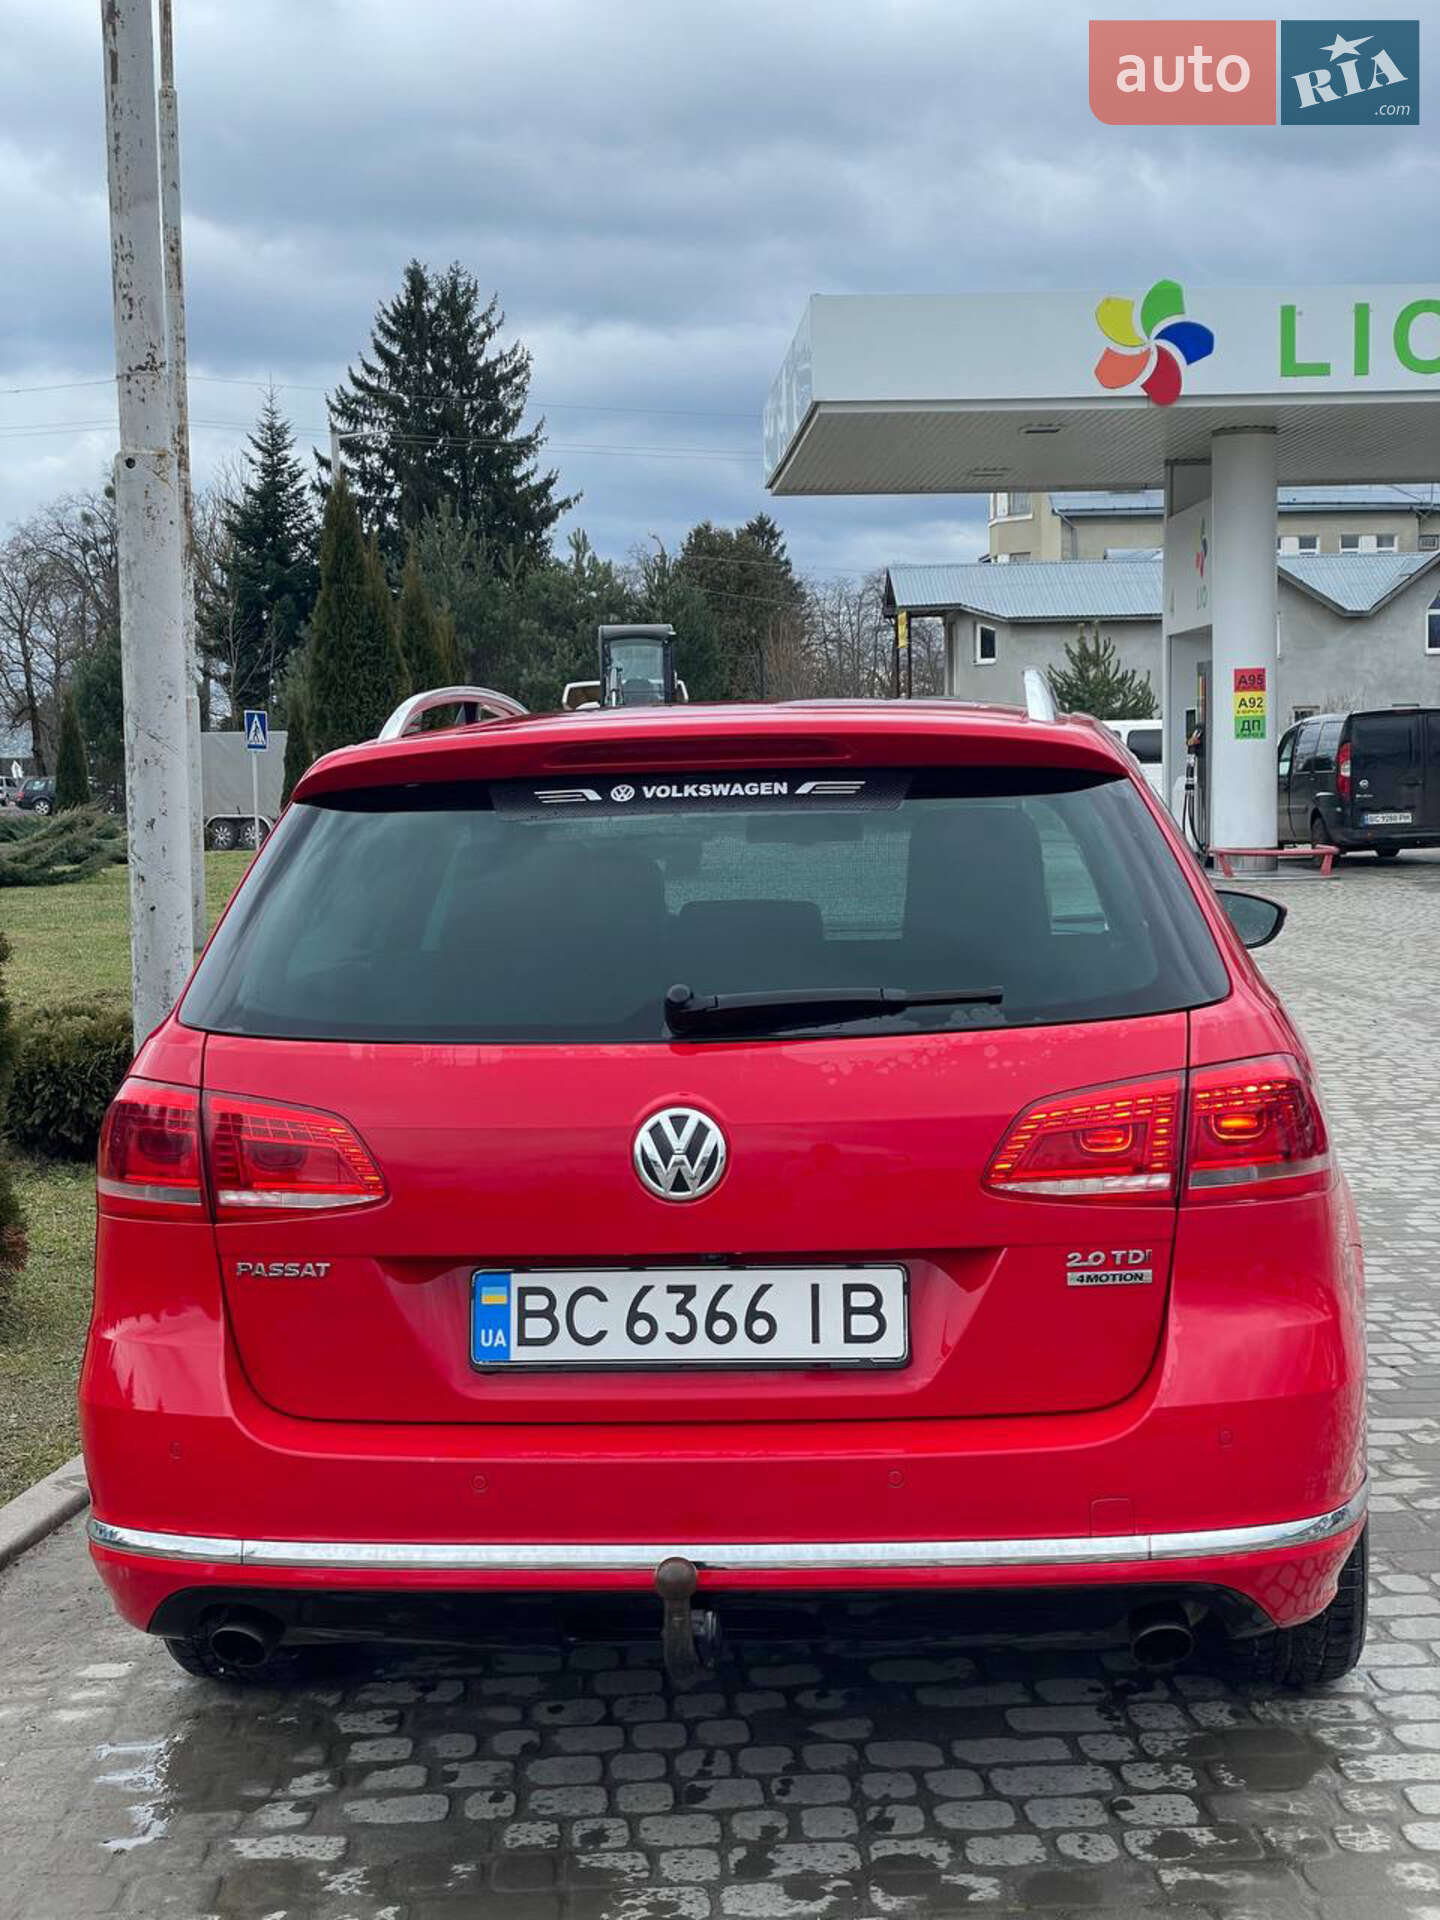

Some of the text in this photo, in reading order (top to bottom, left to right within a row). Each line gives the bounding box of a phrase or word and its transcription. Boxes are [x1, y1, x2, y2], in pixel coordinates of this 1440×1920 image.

[1240, 719, 1261, 733] ДП
[643, 782, 788, 798] VOLKSWAGEN
[1110, 1248, 1153, 1265] TDI
[236, 1262, 331, 1277] PASSAT
[1076, 1272, 1145, 1283] 4MOTION
[516, 1283, 888, 1347] BC 6366 IB
[480, 1330, 507, 1348] UA
